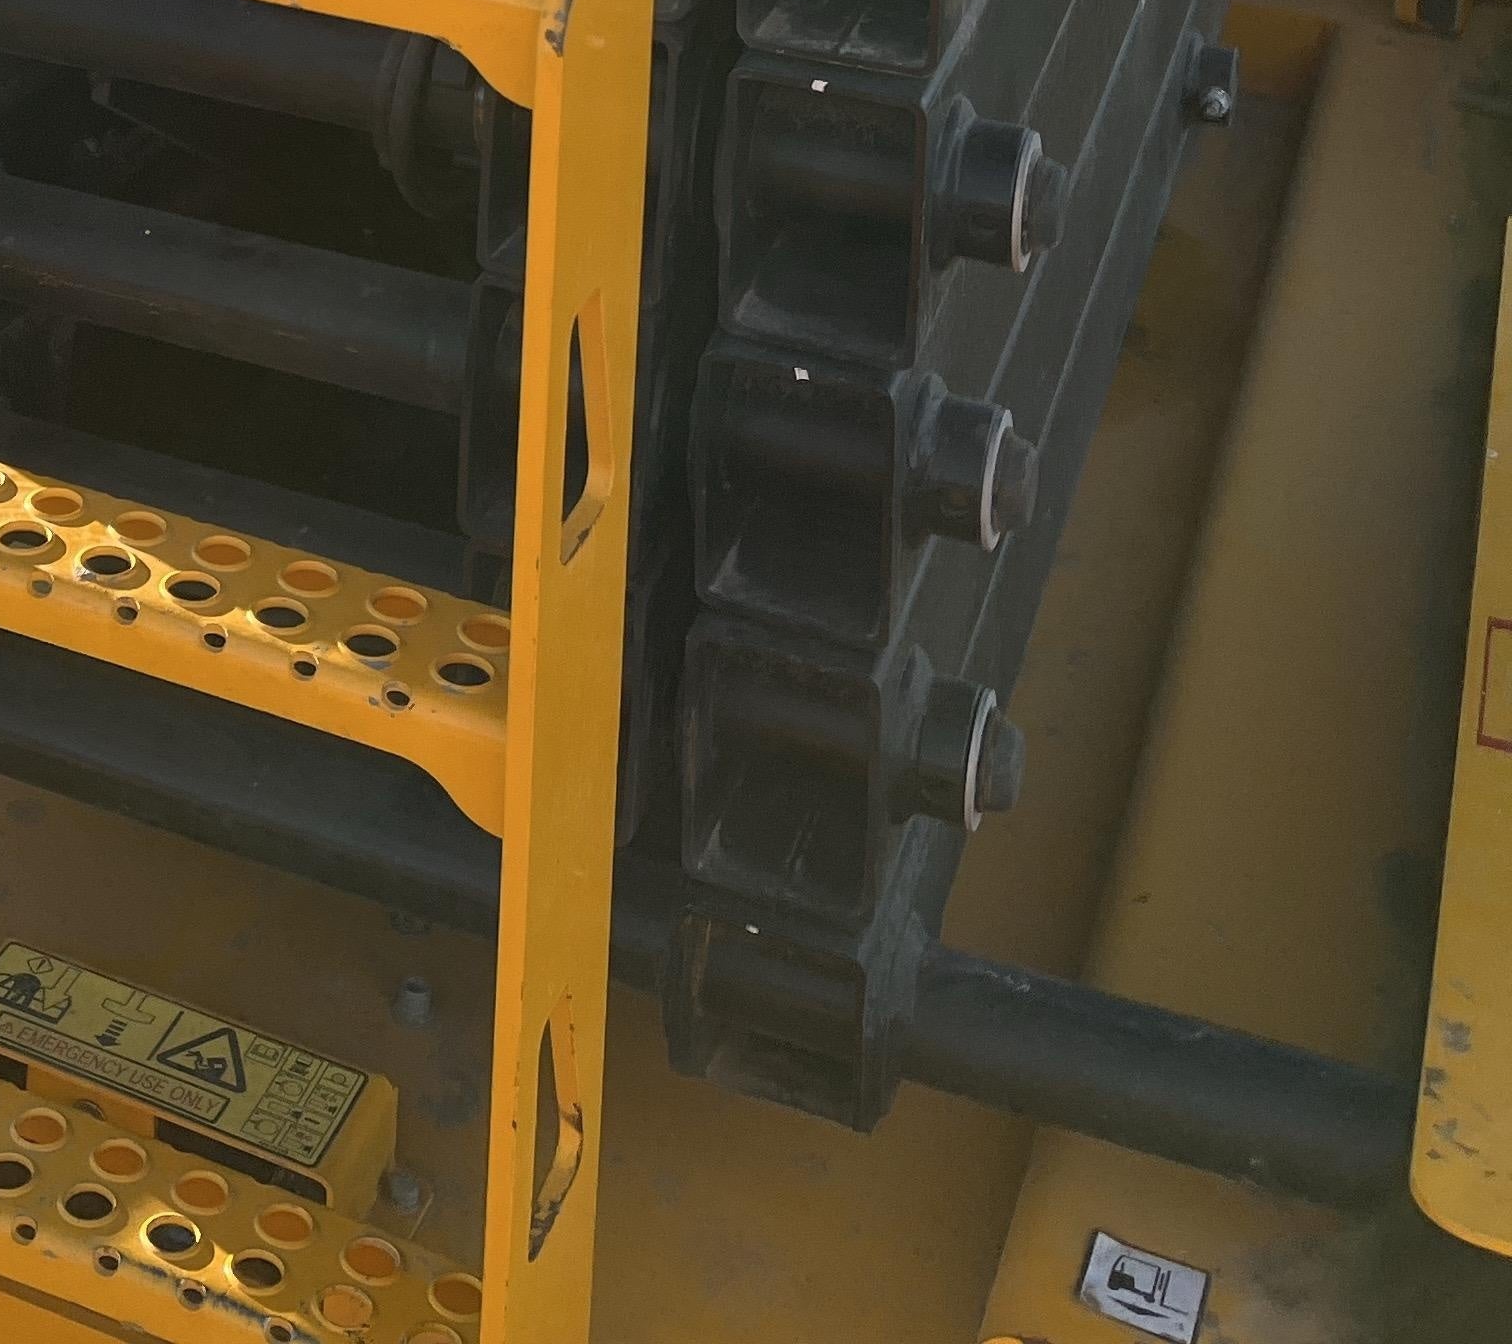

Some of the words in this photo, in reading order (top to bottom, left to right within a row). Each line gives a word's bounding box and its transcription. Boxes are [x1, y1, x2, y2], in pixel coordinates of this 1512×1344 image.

[16, 1026, 129, 1078] EMERGENCY
[128, 1070, 169, 1095] USE
[169, 1085, 222, 1114] ONLY
